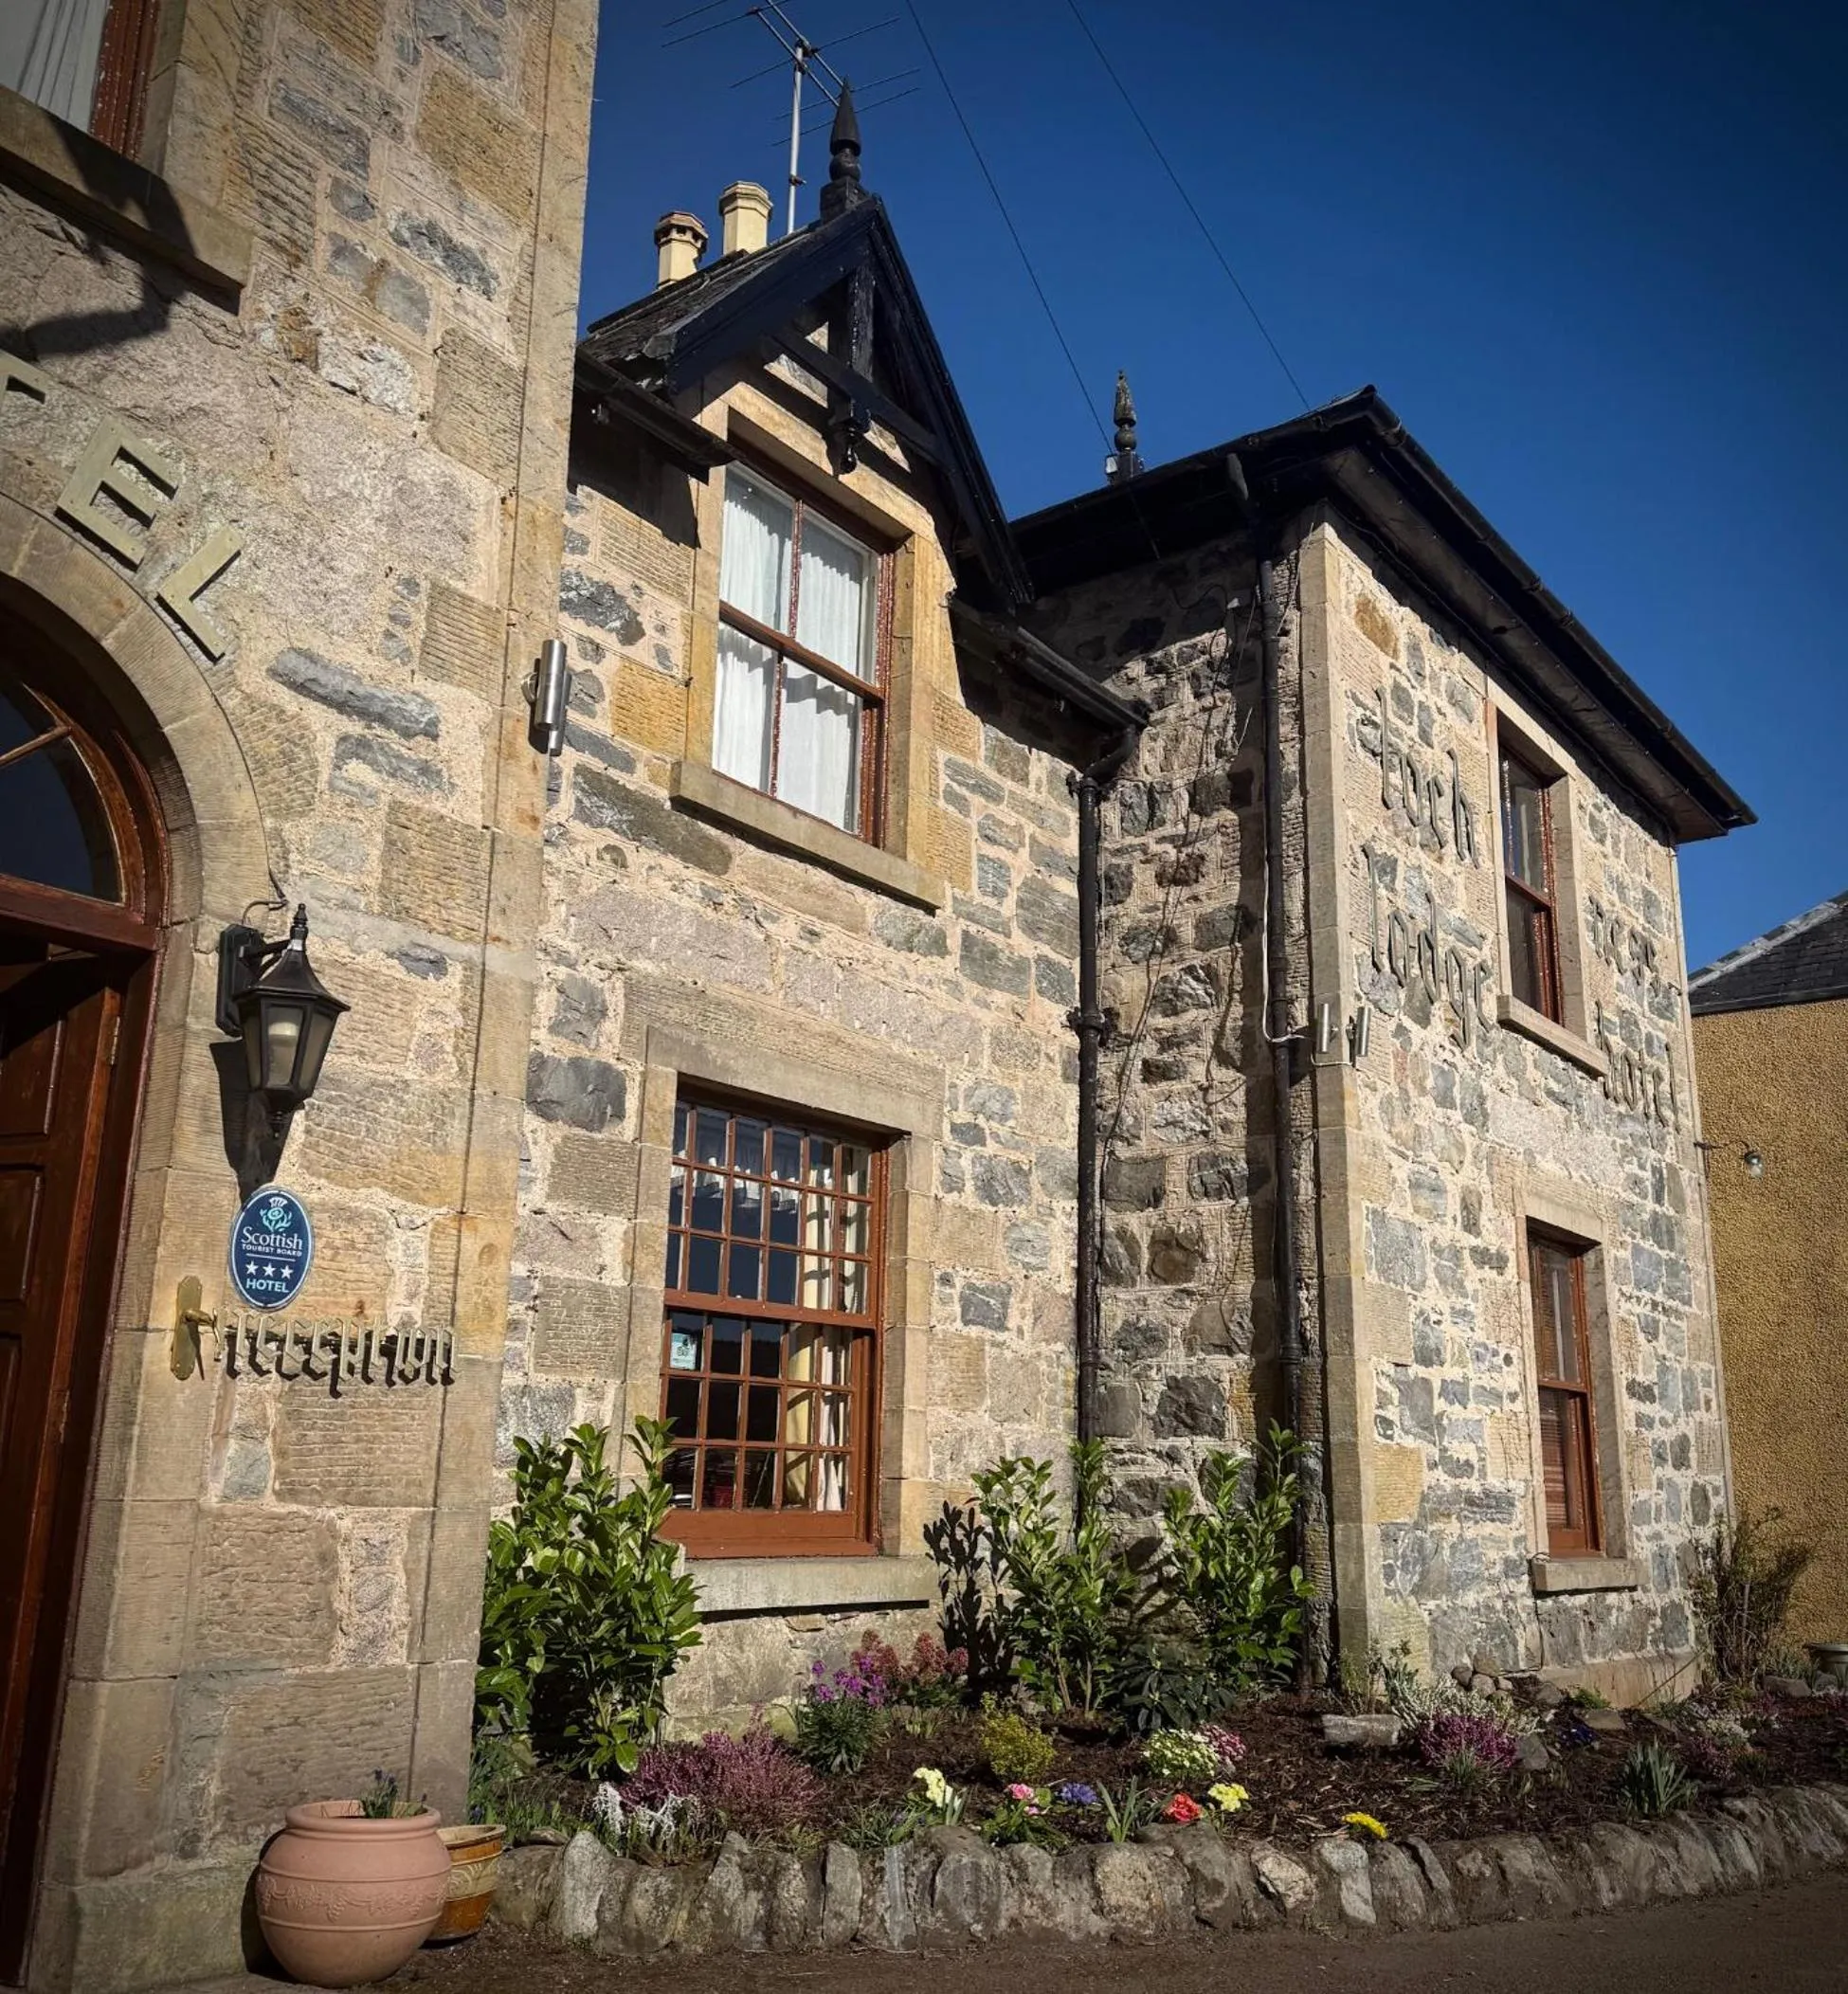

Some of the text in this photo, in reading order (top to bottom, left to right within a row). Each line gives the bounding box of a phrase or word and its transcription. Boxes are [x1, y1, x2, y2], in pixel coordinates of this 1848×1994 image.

[241, 1225, 303, 1251] Scottish
[242, 1243, 303, 1258] TOURIST BOARD
[245, 1278, 290, 1294] HOTEL
